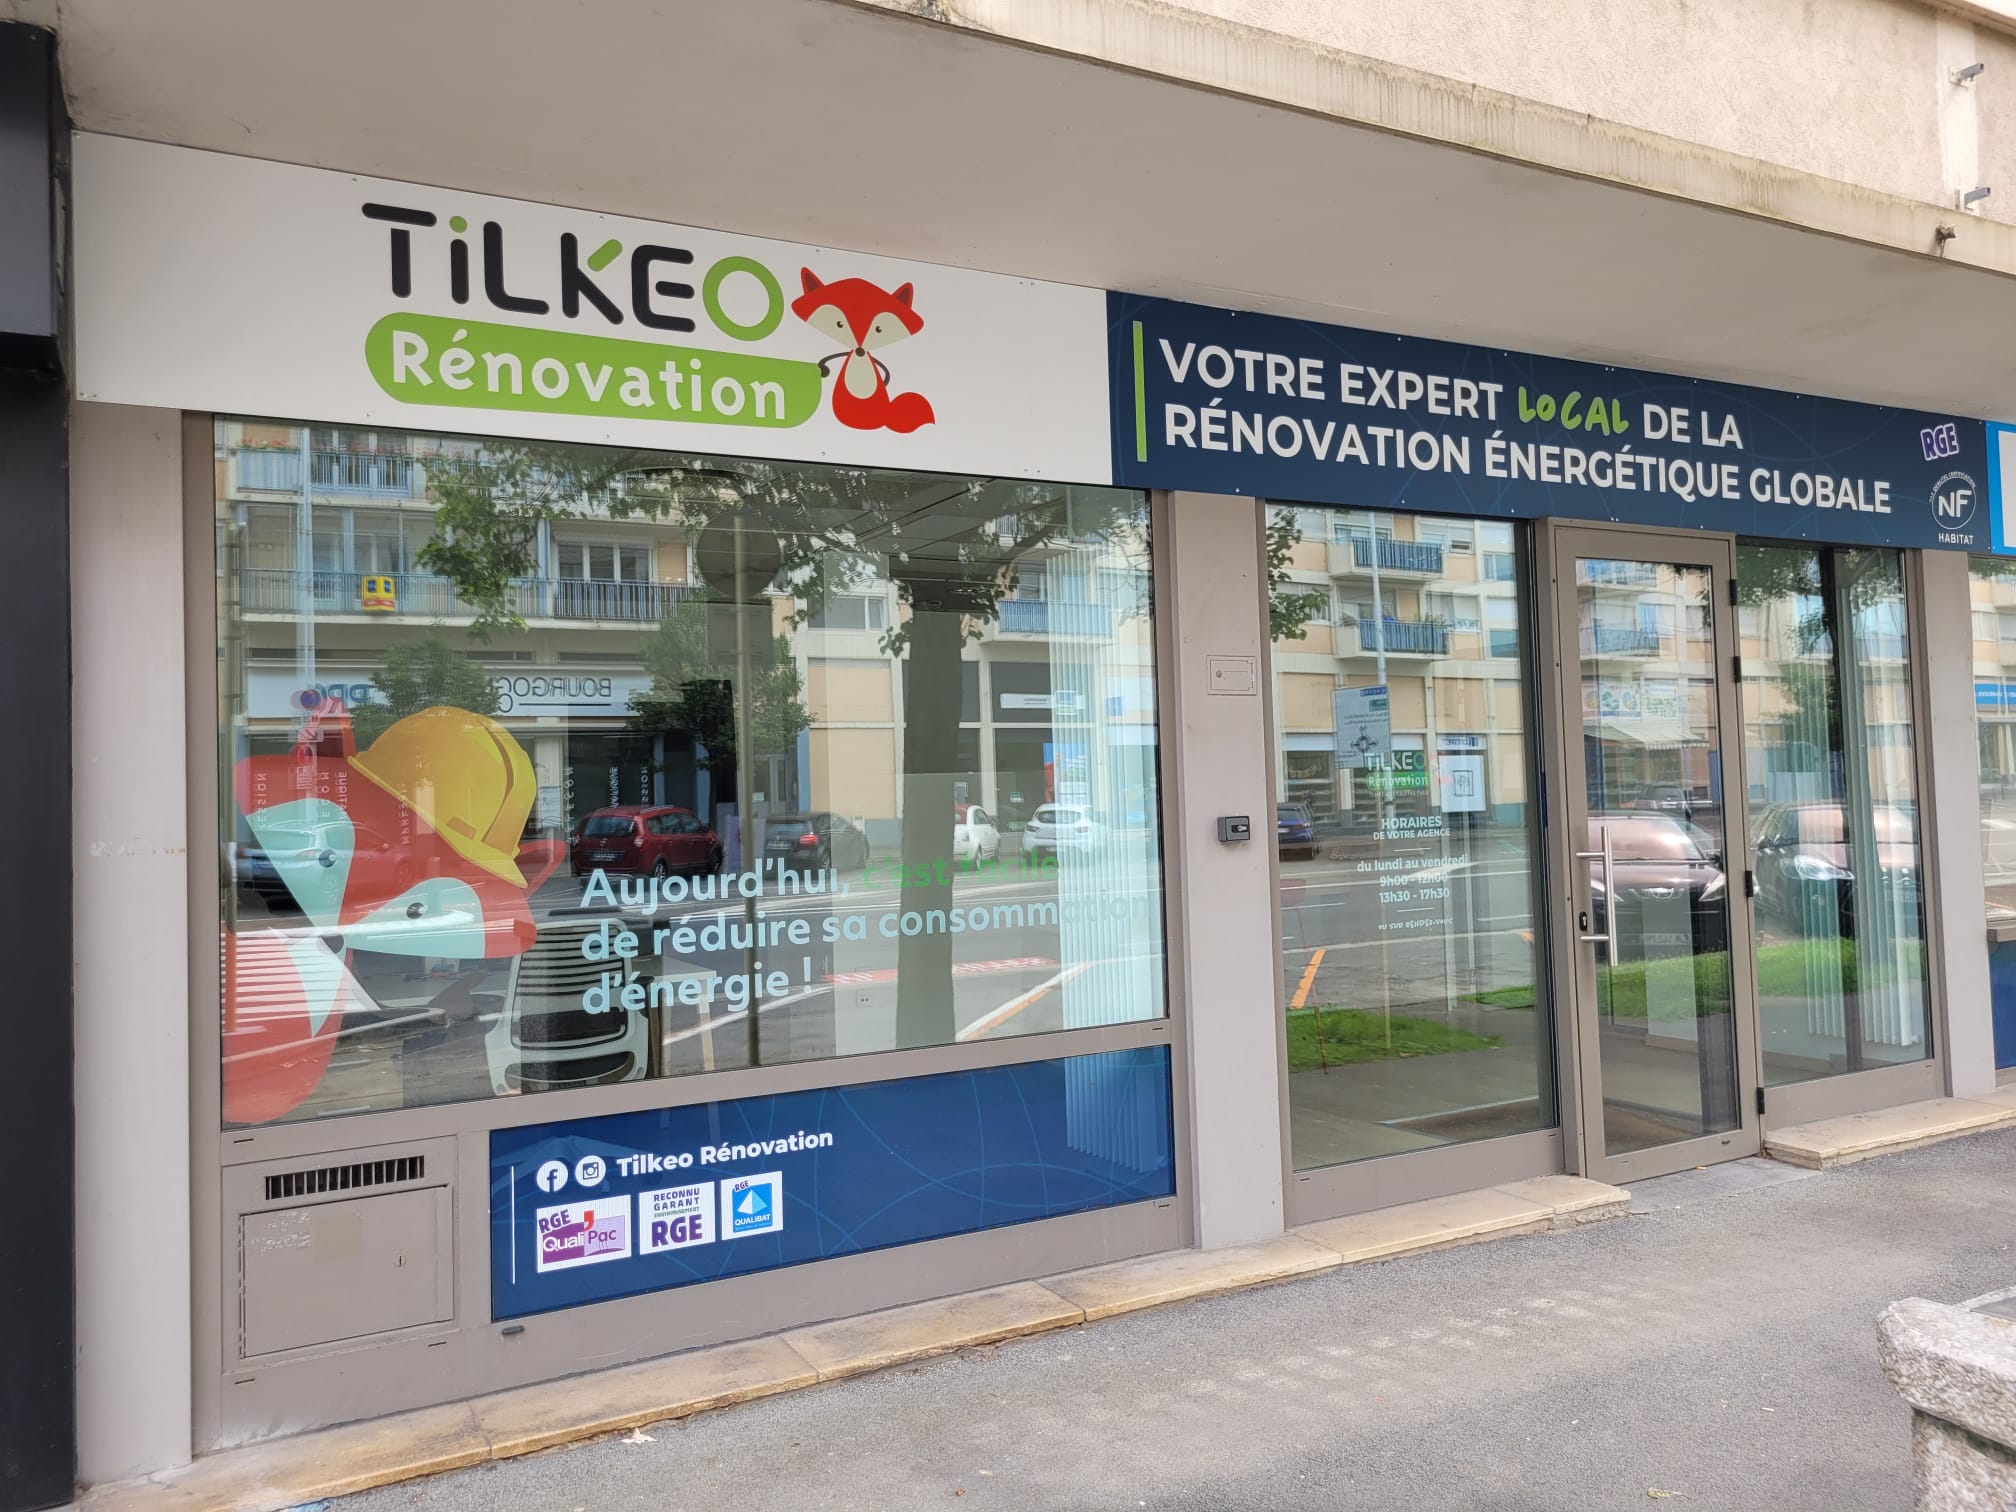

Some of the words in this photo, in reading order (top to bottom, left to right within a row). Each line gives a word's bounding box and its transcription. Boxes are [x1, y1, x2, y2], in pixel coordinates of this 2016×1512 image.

[392, 328, 785, 420] Rénovation
[1158, 338, 1325, 400] VOTRE
[1340, 362, 1503, 420] EXPERT
[1643, 403, 1691, 443] DE
[1700, 410, 1744, 450] LA
[1921, 423, 1959, 461] RGE
[1164, 397, 1470, 475] RÉNOVATION
[1484, 430, 1740, 503] ÉNERGÉTIQUE
[1749, 467, 1892, 514] GLOBALE
[1938, 489, 1972, 518] NF
[1938, 533, 1974, 545] HABITAT
[1381, 815, 1442, 829] HORAIRES
[1373, 831, 1385, 840] DE
[1387, 830, 1415, 840] VOTRE
[1417, 828, 1451, 838] AGENCE
[863, 855, 950, 889] c'est
[1357, 861, 1371, 872] du
[1374, 859, 1403, 871] lundi
[1405, 859, 1418, 869] au
[1421, 854, 1468, 868] vendredi
[1379, 875, 1408, 887] 9h00
[1417, 873, 1448, 885] 12h00
[1379, 891, 1410, 903] 13h30
[1419, 888, 1450, 901] 17h30
[581, 920, 638, 961] de
[653, 906, 811, 956] réduire
[821, 912, 867, 942] sa
[616, 1152, 694, 1177] Tilkeo
[700, 1130, 834, 1165] Rénovation
[653, 1187, 700, 1202] RECONNU
[734, 1180, 749, 1192] RGE
[653, 1197, 700, 1212] GARANT
[538, 1209, 571, 1234] RGE
[651, 1213, 703, 1248] RGE
[734, 1213, 771, 1227] QUALIBAT
